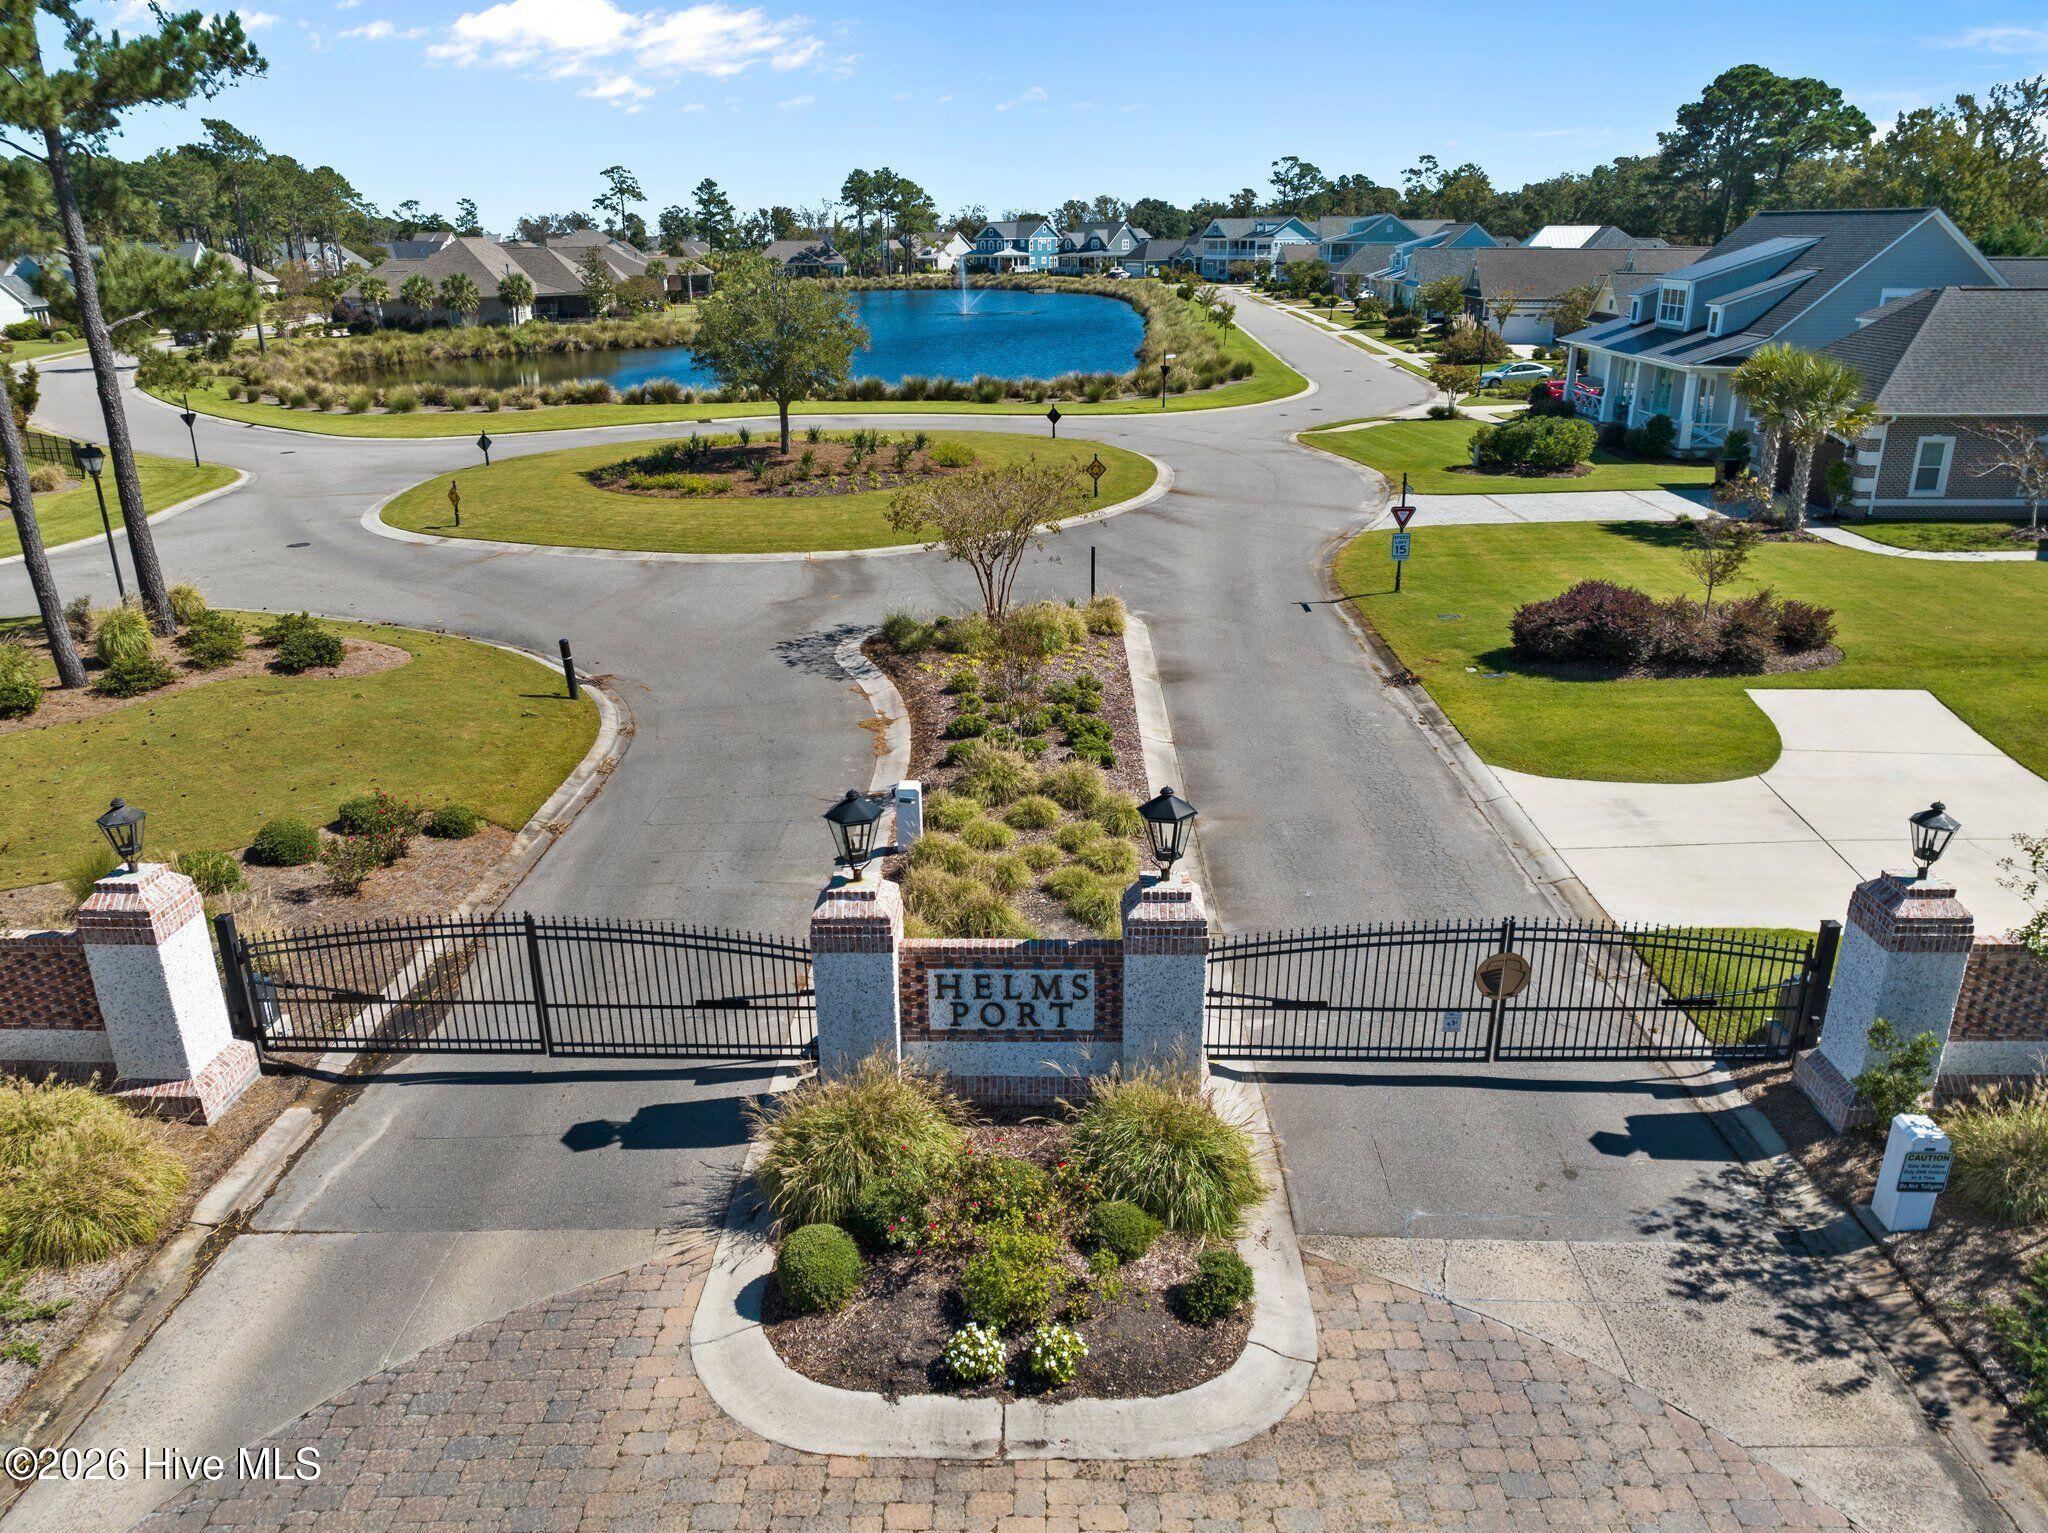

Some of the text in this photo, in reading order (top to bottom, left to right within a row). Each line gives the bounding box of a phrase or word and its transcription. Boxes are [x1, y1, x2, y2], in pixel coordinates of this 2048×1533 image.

[1395, 545, 1407, 554] 15
[934, 973, 1089, 1000] HELMS
[950, 1002, 1074, 1028] PORT
